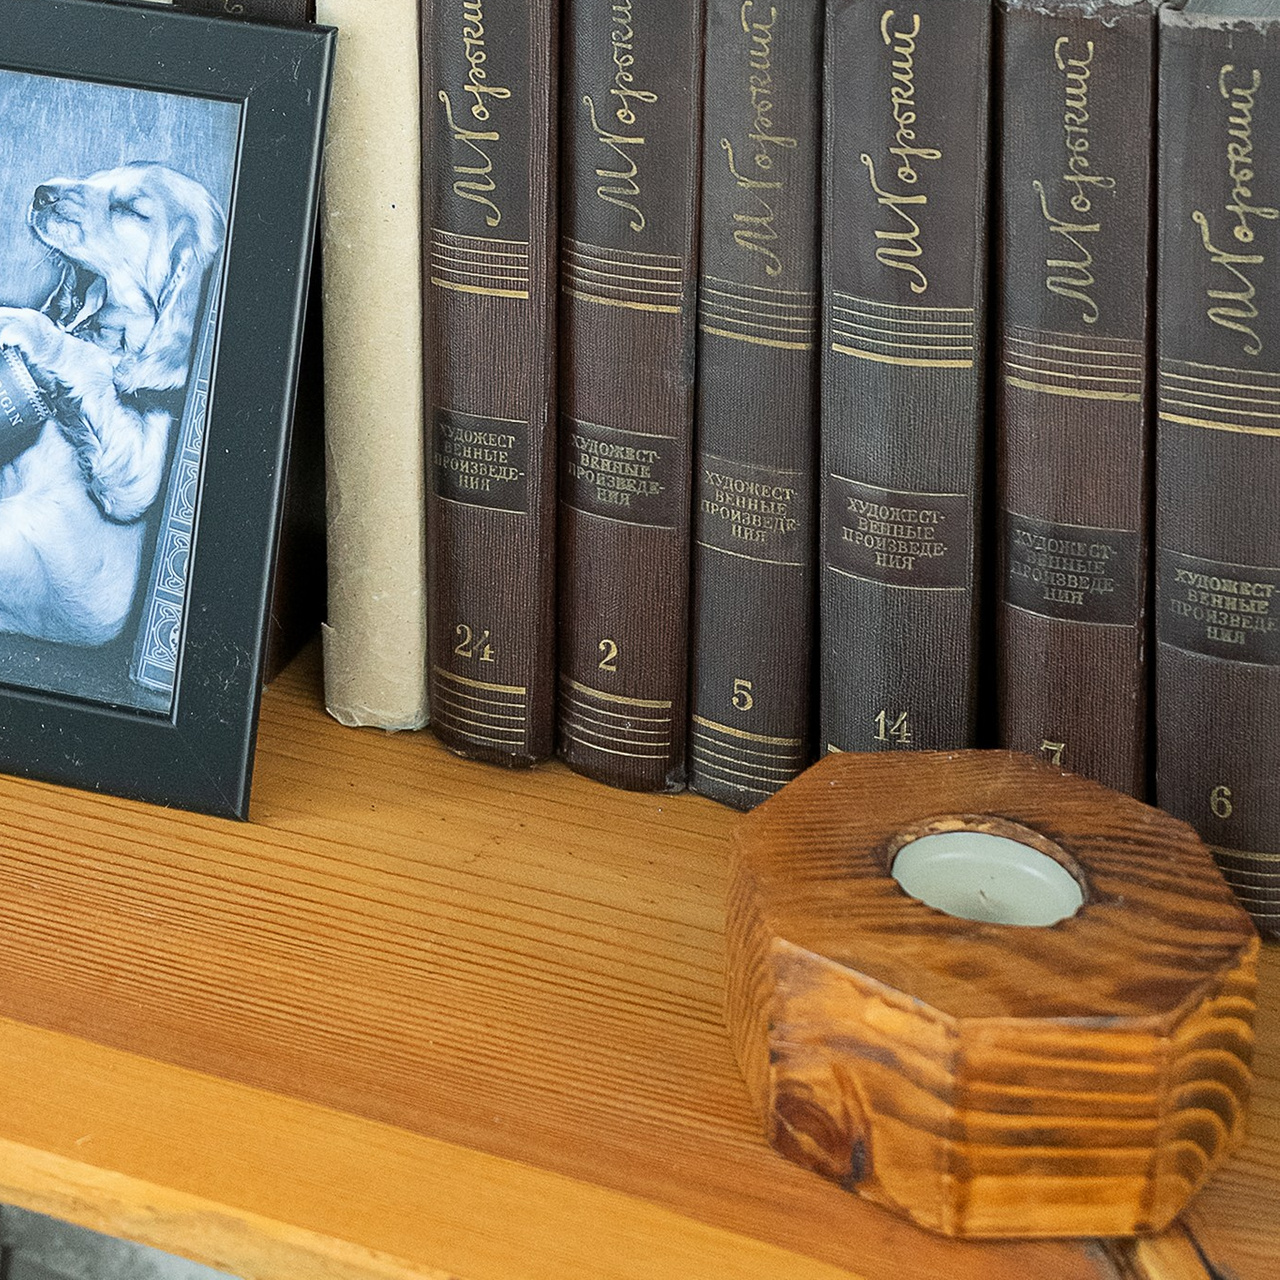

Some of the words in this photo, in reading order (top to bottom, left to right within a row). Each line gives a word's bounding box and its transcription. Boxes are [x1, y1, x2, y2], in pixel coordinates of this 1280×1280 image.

[857, 516, 936, 540] ВЕННЫЕ
[874, 551, 916, 571] НИЯ
[454, 624, 495, 662] 24
[598, 639, 618, 672] 2
[731, 679, 753, 711] 5
[873, 709, 912, 744] 14
[1040, 739, 1066, 767] 7
[1209, 786, 1233, 819] 6
